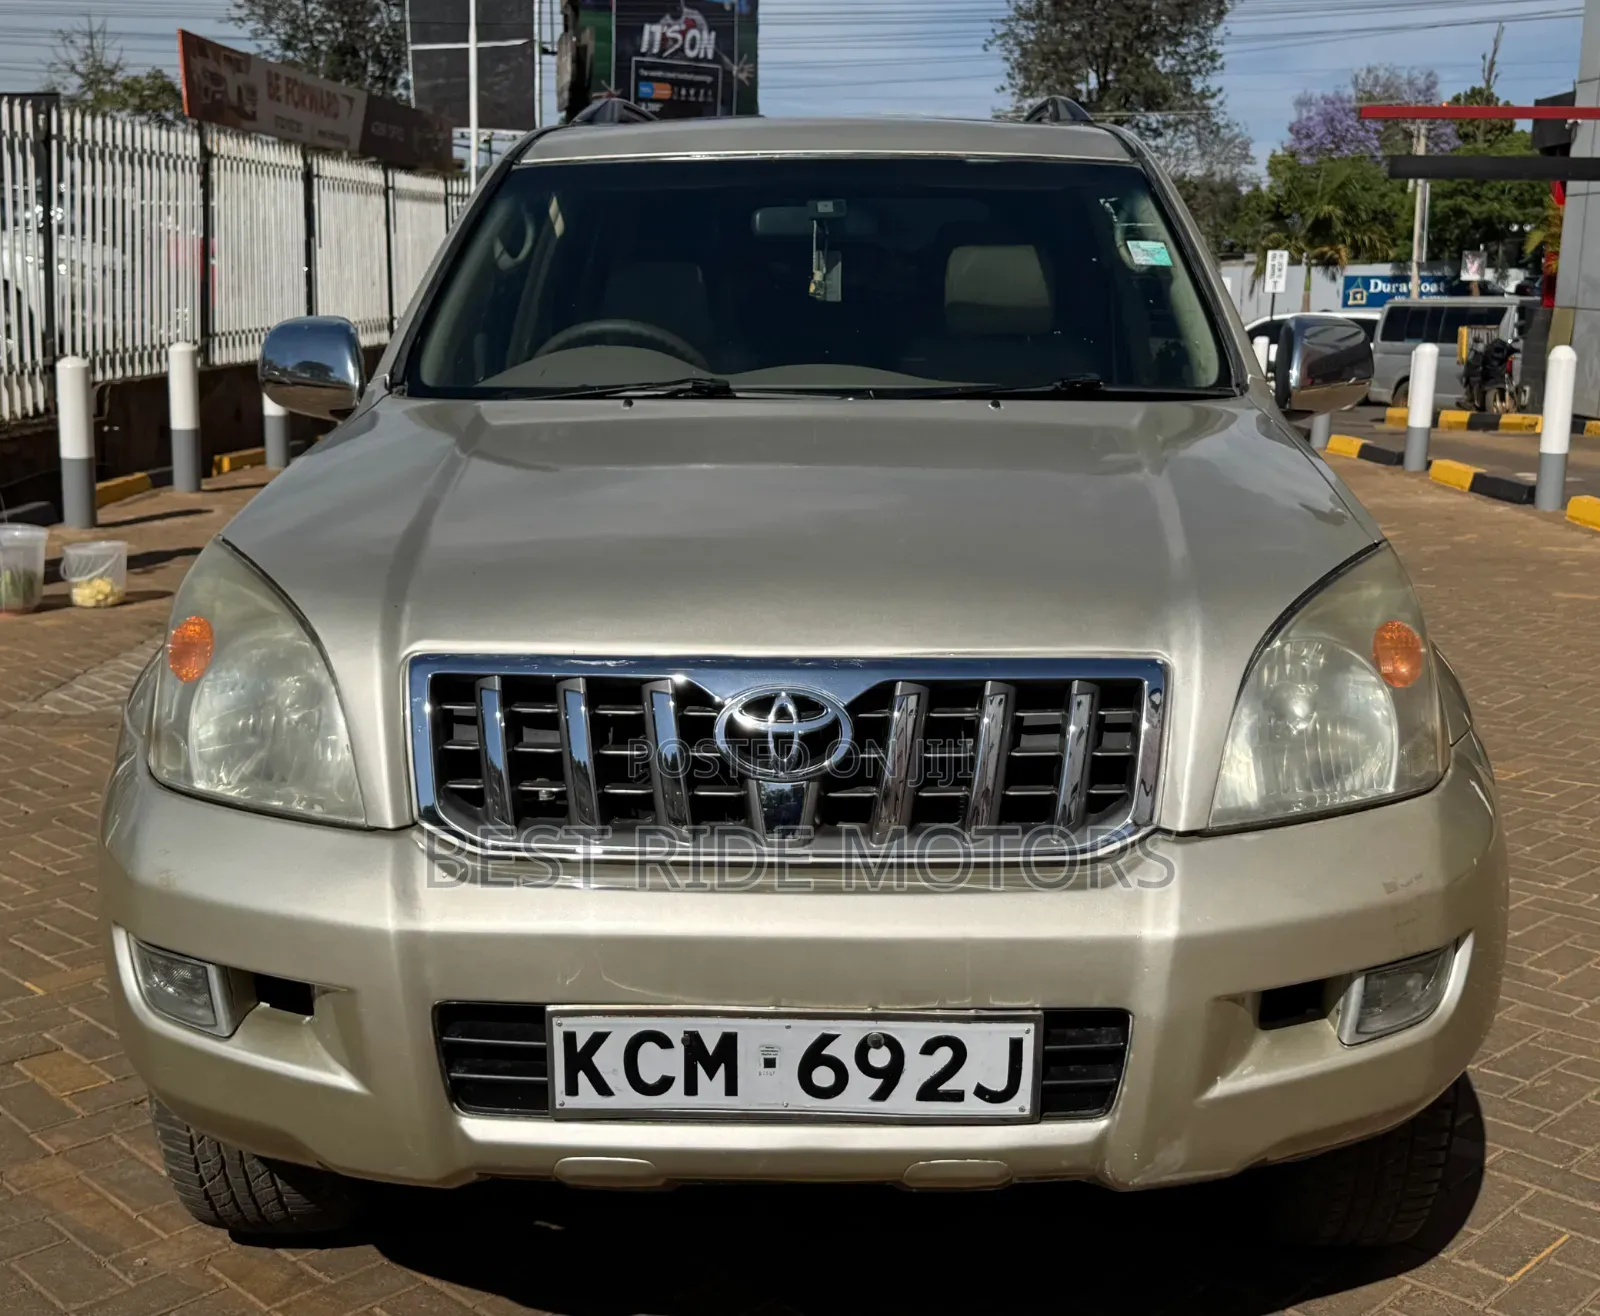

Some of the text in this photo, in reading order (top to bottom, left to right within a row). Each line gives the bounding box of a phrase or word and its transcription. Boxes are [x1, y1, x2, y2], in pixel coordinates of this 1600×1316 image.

[640, 23, 716, 60] IT'S ON
[562, 1029, 1024, 1104] KCM 692J
